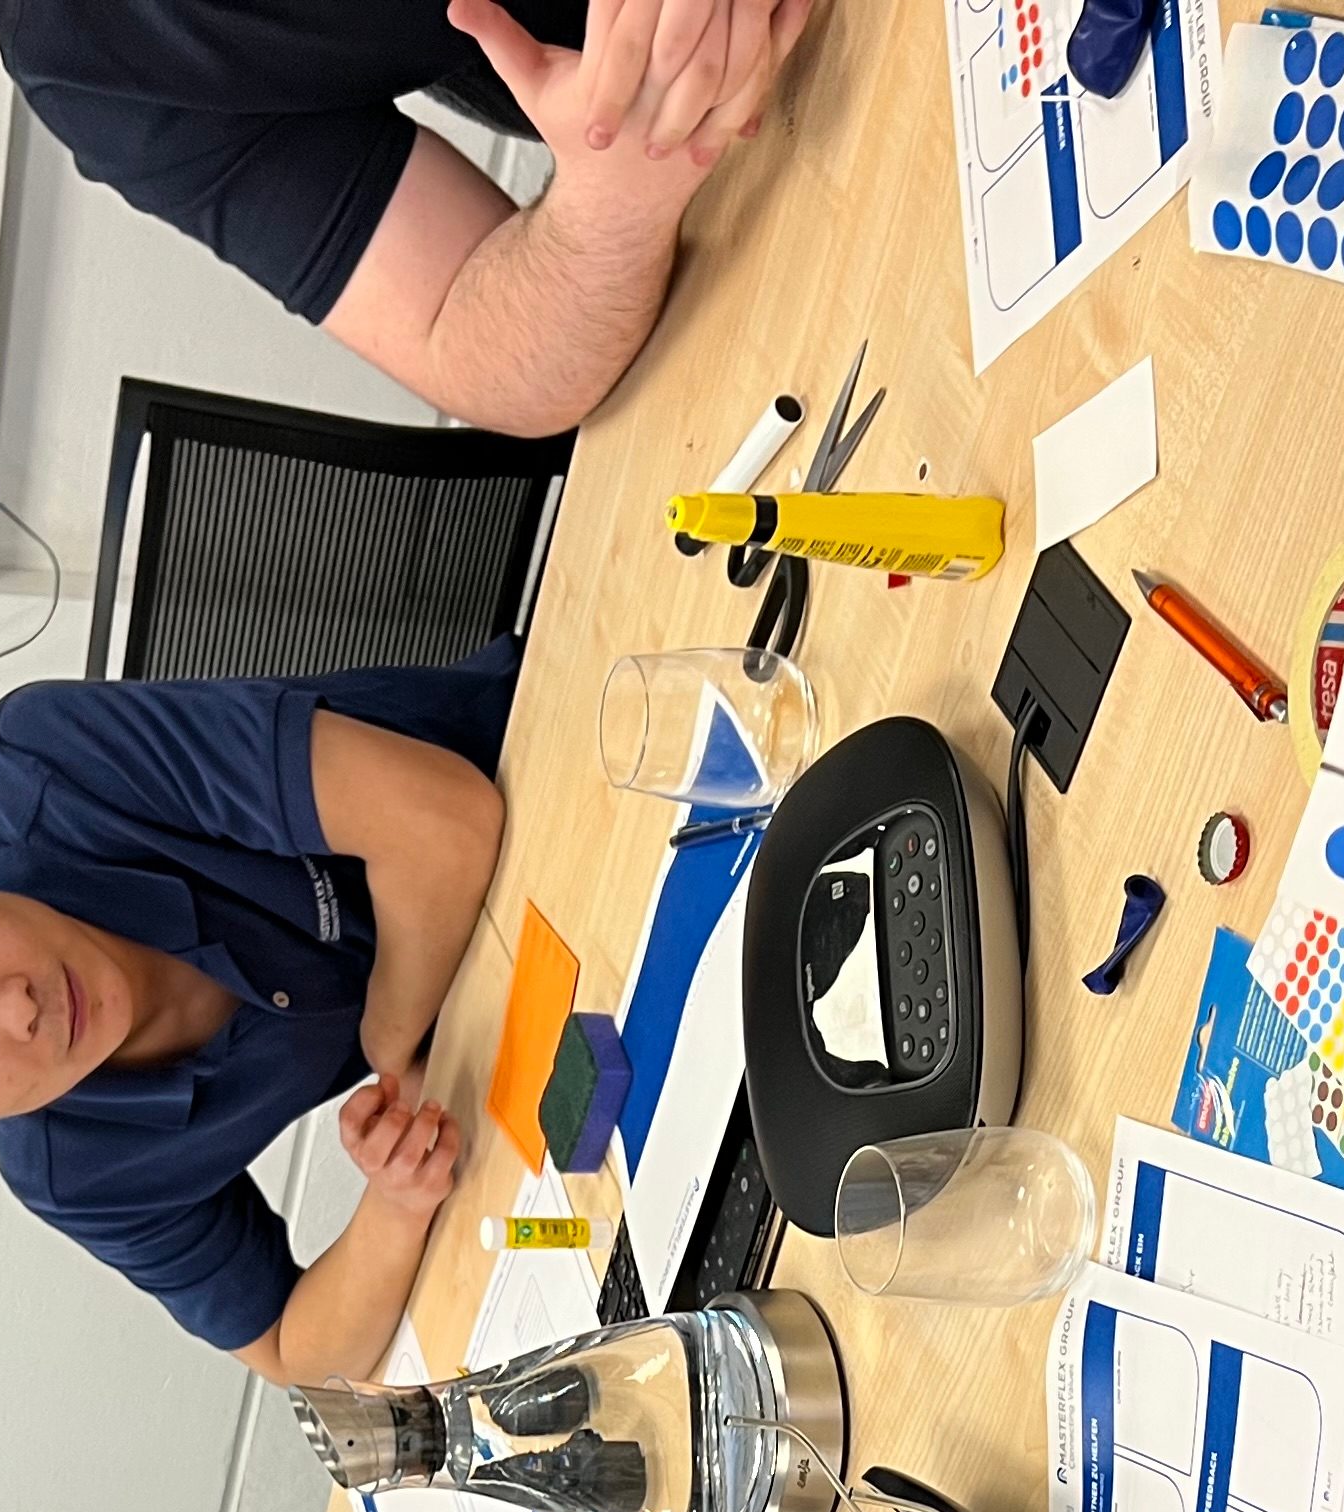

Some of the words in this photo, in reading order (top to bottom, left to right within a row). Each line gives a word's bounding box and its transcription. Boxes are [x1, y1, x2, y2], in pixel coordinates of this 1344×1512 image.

[1200, 52, 1212, 118] GROUP
[1113, 1157, 1125, 1218] GROUP
[1136, 1233, 1145, 1255] EIN
[1058, 1297, 1076, 1356] GROUP
[1066, 1364, 1075, 1402] Values
[1057, 1362, 1068, 1466] MASTERFLEX
[1068, 1403, 1077, 1470] Connecting
[1090, 1417, 1099, 1462] HELFEN
[1090, 1463, 1099, 1480] ZU
